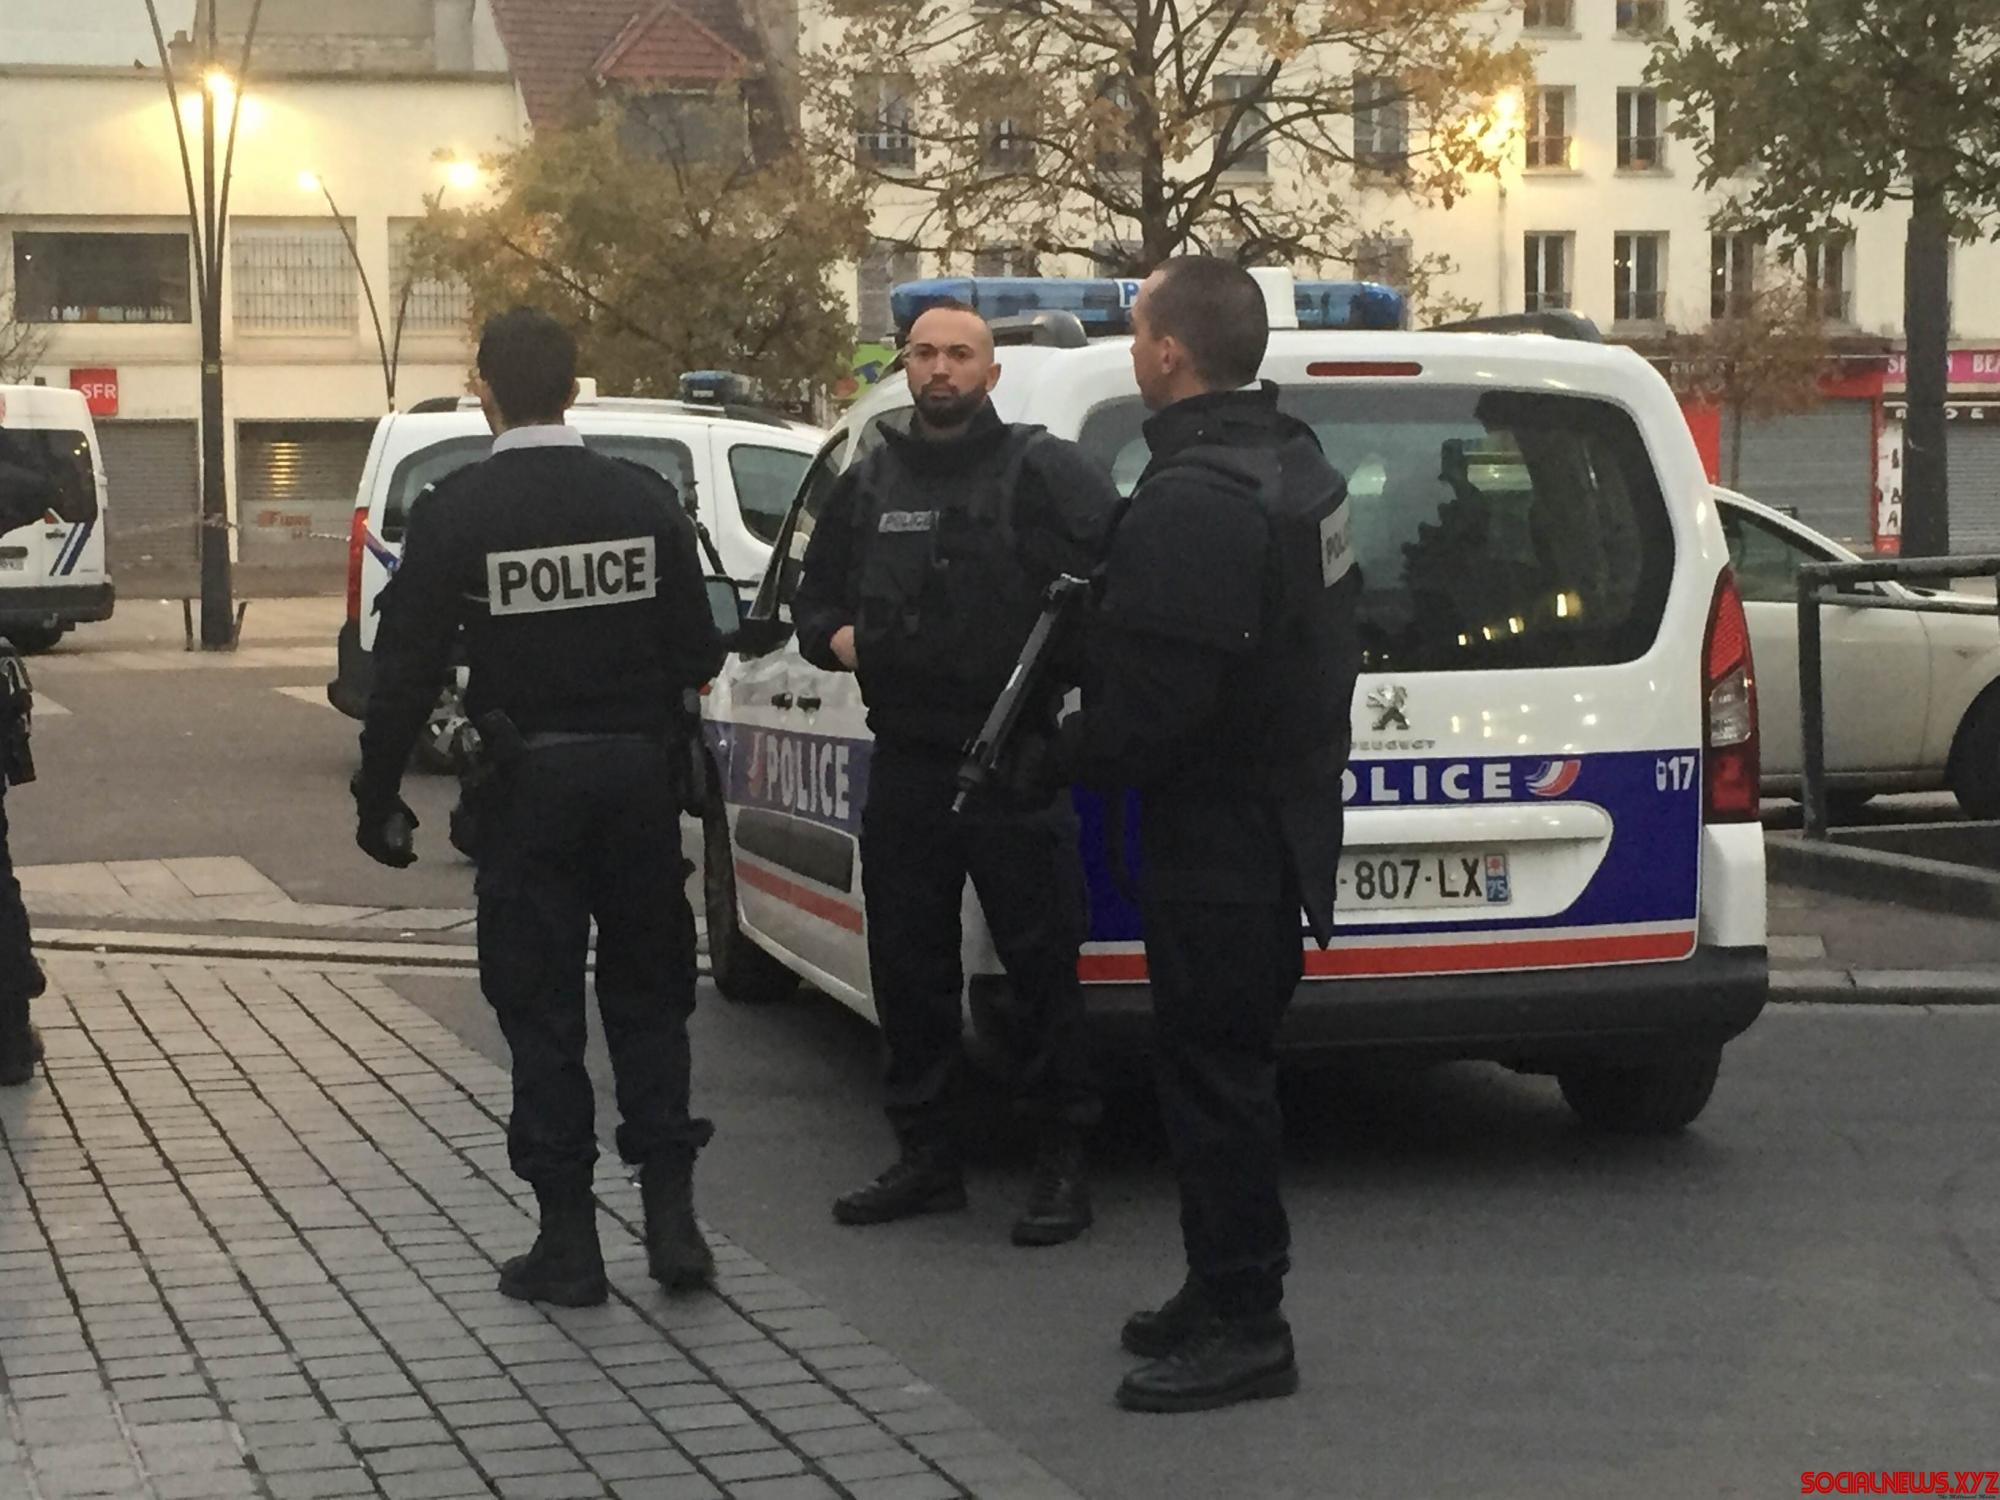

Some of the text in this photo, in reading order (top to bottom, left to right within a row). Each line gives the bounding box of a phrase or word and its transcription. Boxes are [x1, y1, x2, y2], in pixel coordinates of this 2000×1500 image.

[81, 383, 116, 399] SFR
[498, 547, 646, 606] POLICE
[766, 734, 849, 819] POLICE
[1341, 763, 1512, 802] LICE
